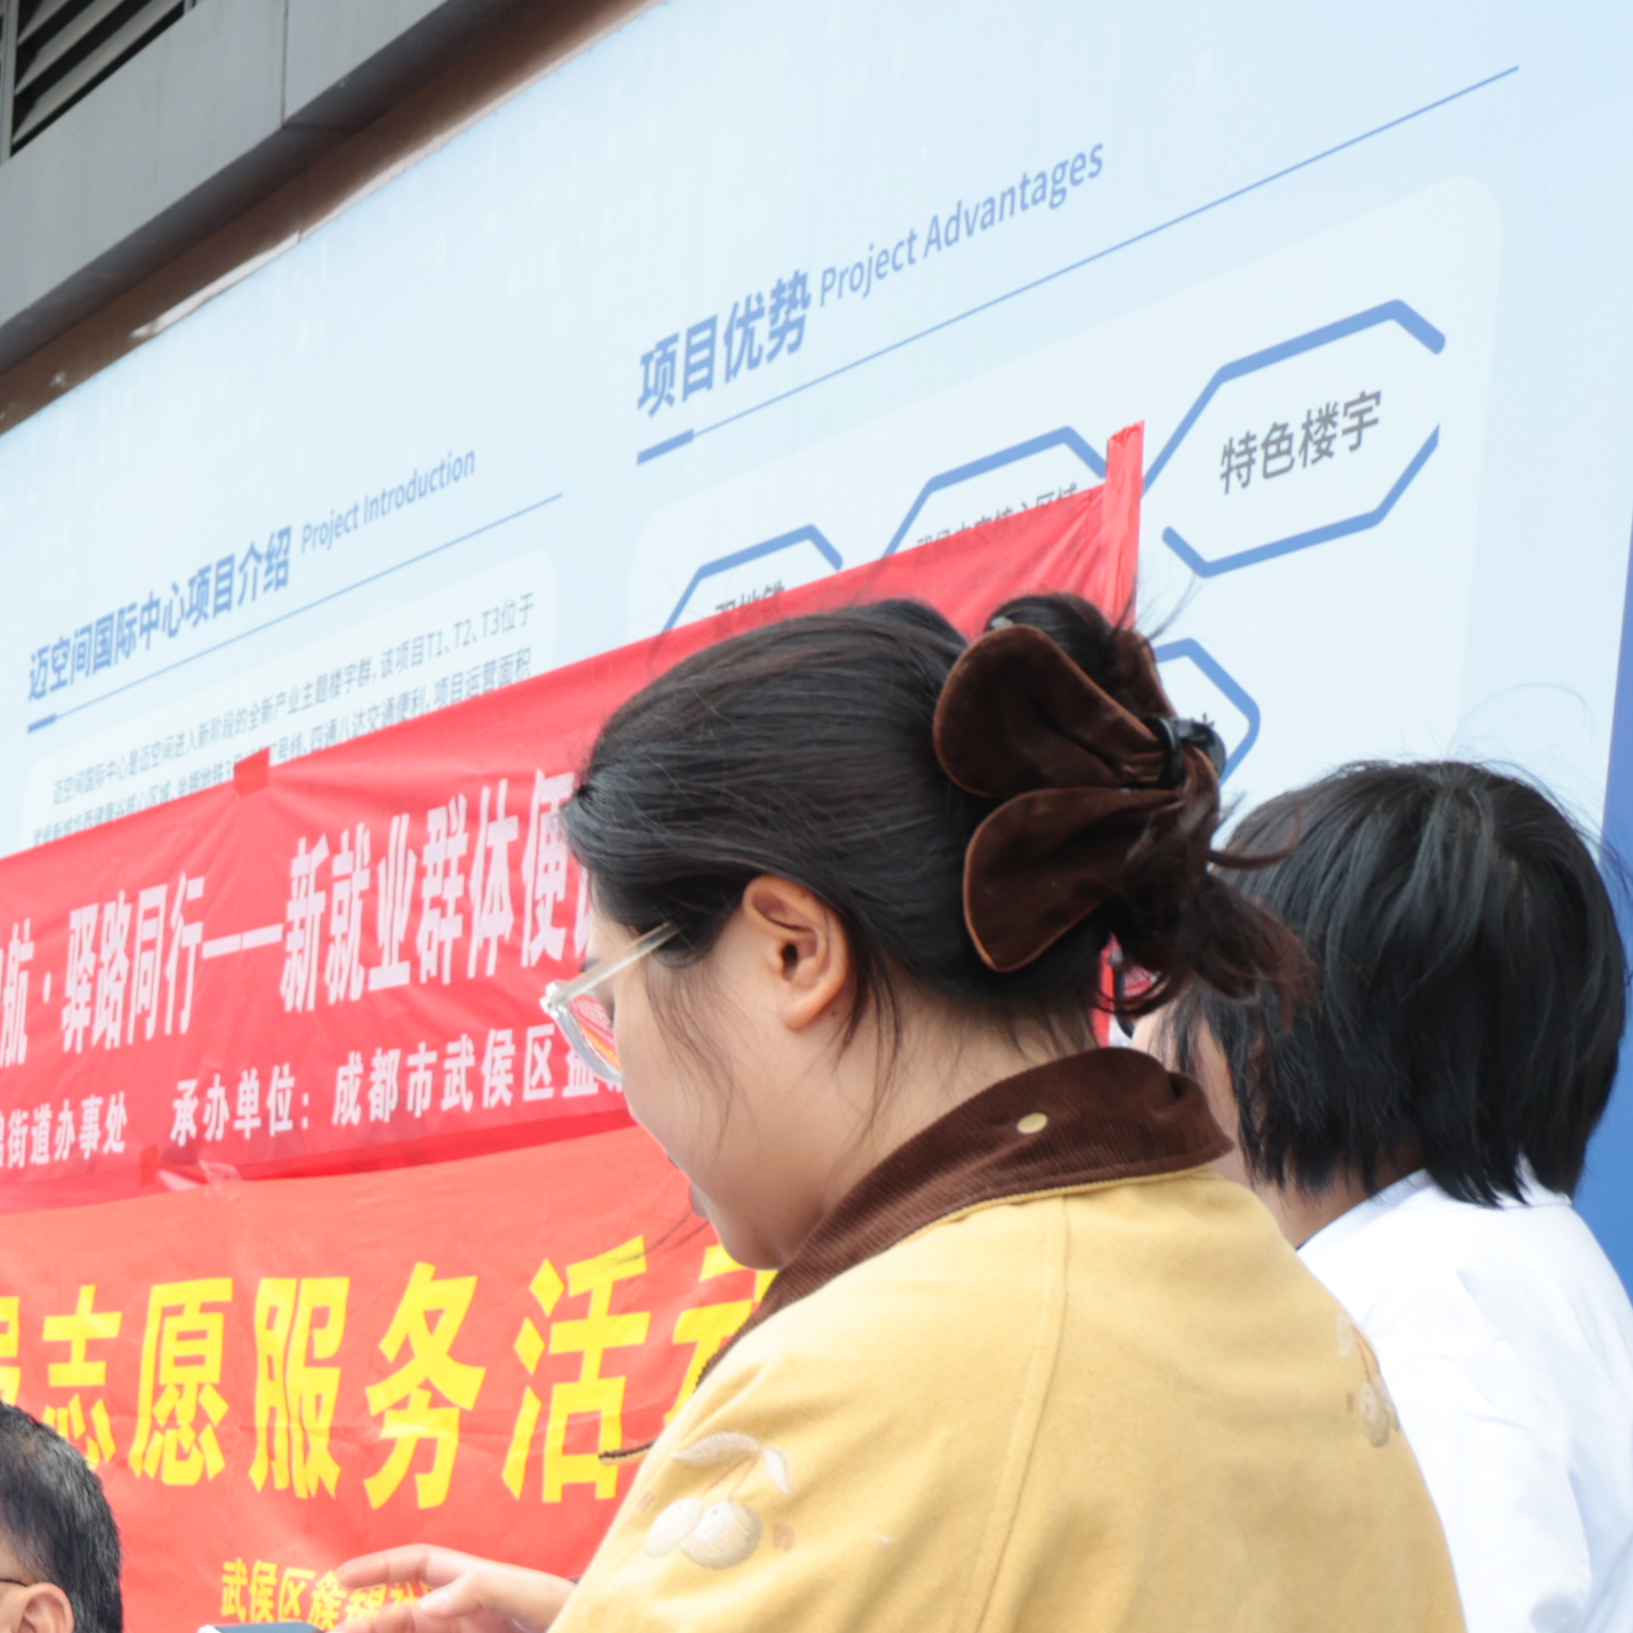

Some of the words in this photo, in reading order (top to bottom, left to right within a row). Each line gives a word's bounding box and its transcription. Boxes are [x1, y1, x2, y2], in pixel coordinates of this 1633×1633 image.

[637, 270, 811, 418] 项目优势
[818, 224, 918, 309] Project
[923, 141, 1105, 260] Advantages
[1218, 388, 1383, 496] 特色楼宇
[27, 524, 294, 703] 迈空间国际中心项目介绍
[301, 518, 360, 557] Project
[363, 445, 477, 528] Introduction
